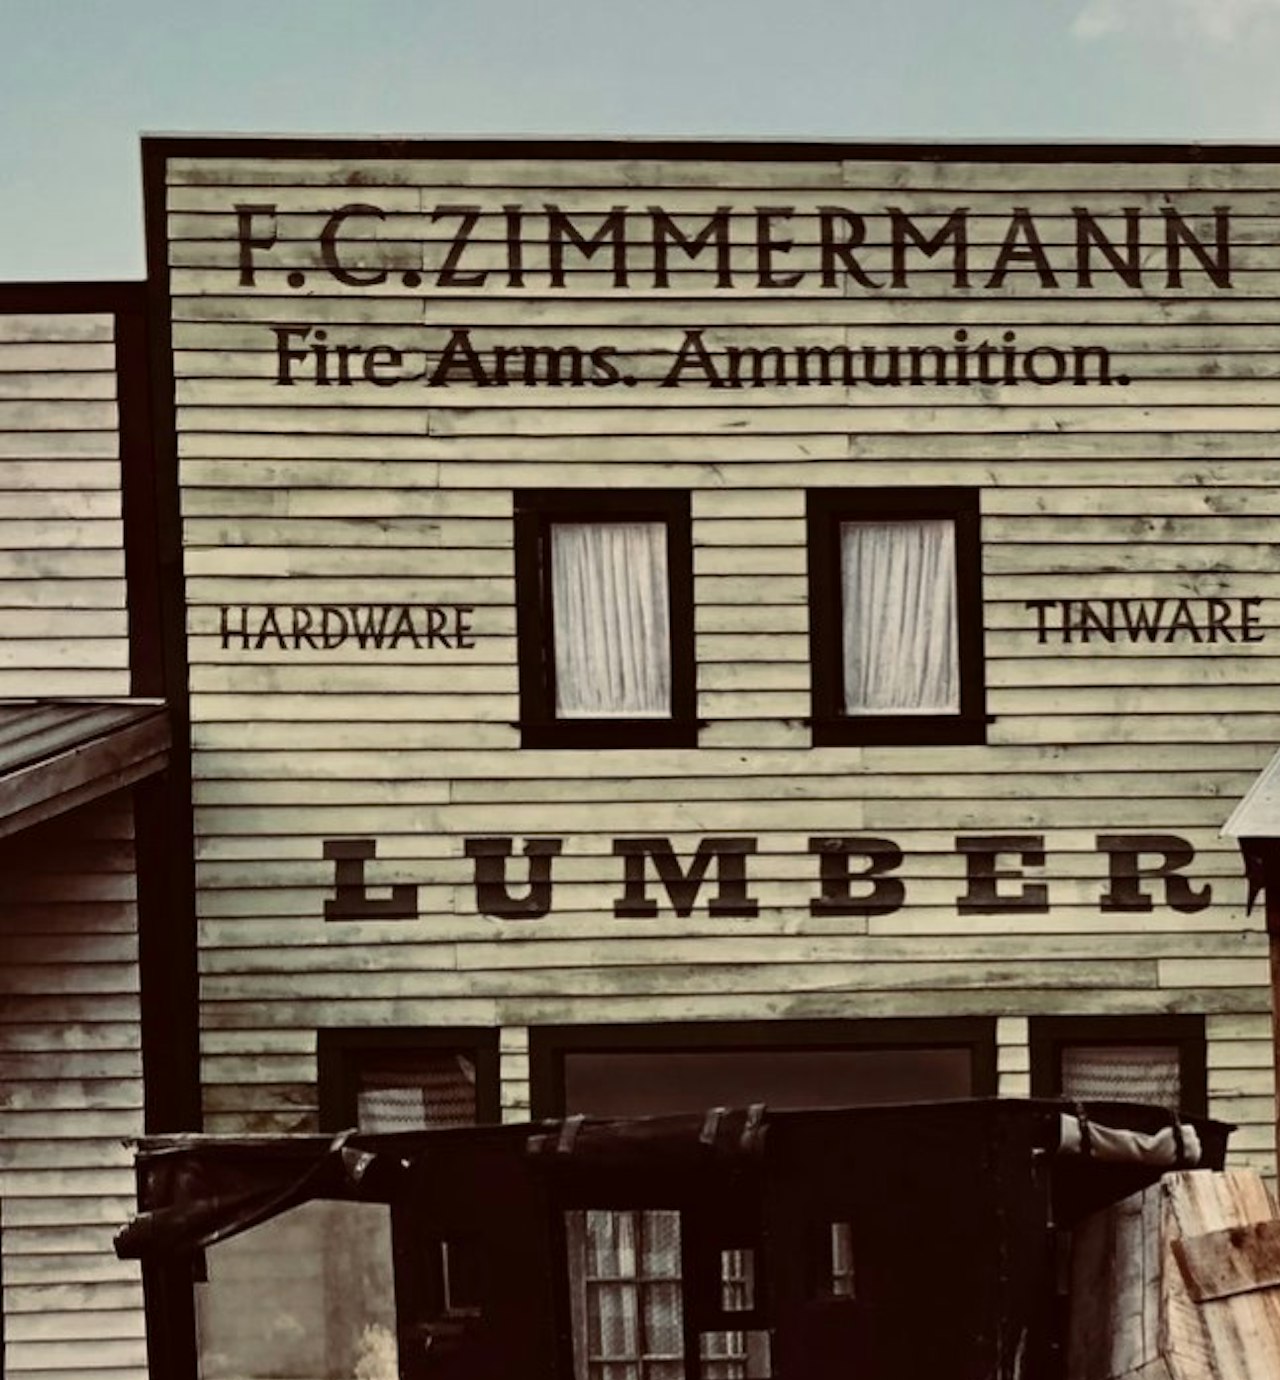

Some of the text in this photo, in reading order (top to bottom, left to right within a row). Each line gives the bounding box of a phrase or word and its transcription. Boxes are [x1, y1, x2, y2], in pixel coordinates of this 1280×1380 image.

[270, 326, 1131, 388] Fire Arms. Ammunition.
[219, 605, 475, 650] HARDWARE
[1025, 597, 1266, 644] TINWARE
[322, 832, 1213, 922] LUMBER
